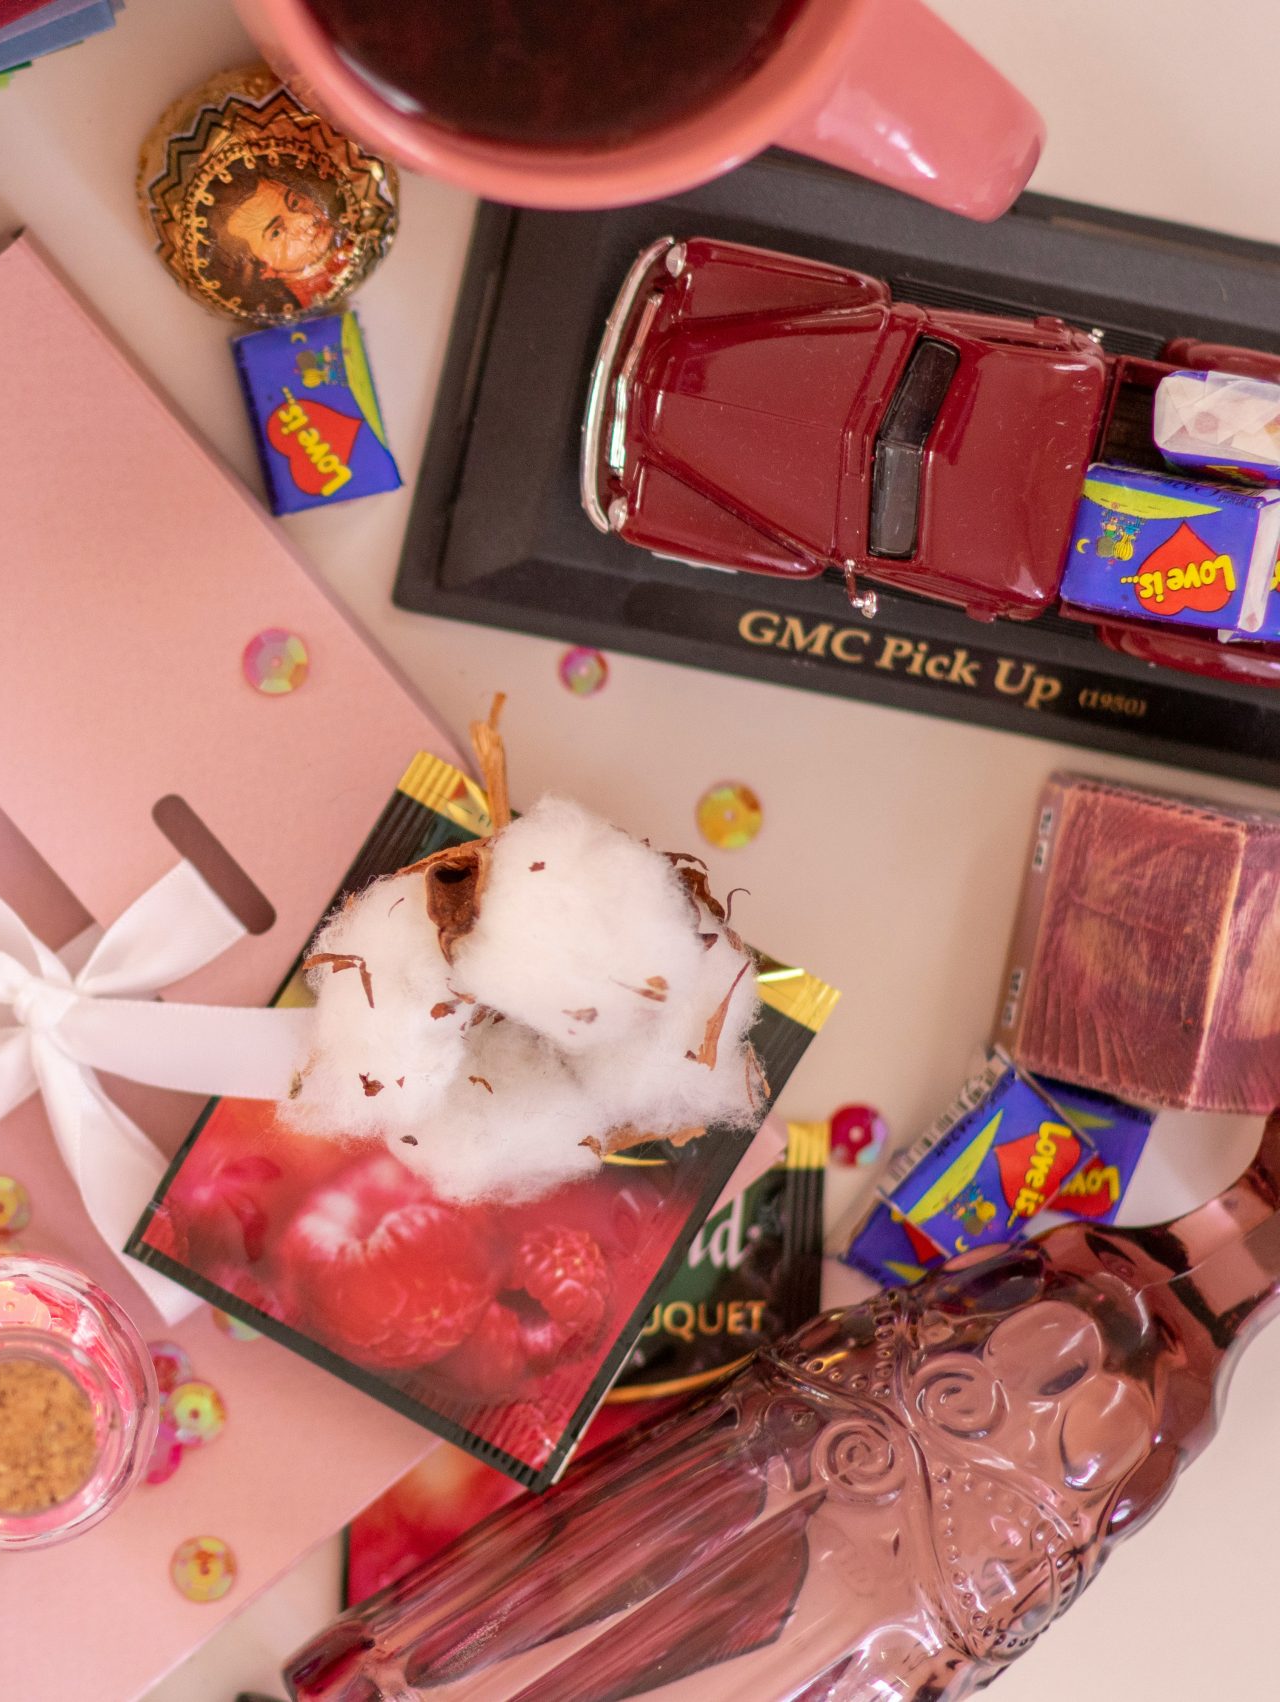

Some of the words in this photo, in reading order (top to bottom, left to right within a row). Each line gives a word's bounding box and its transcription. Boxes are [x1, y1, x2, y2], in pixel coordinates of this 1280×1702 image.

[297, 427, 352, 497] Love
[1167, 554, 1236, 592] Love
[737, 609, 868, 664] GMC
[874, 635, 981, 688] Pick
[993, 657, 1063, 709] Up
[1025, 1121, 1072, 1188] Love
